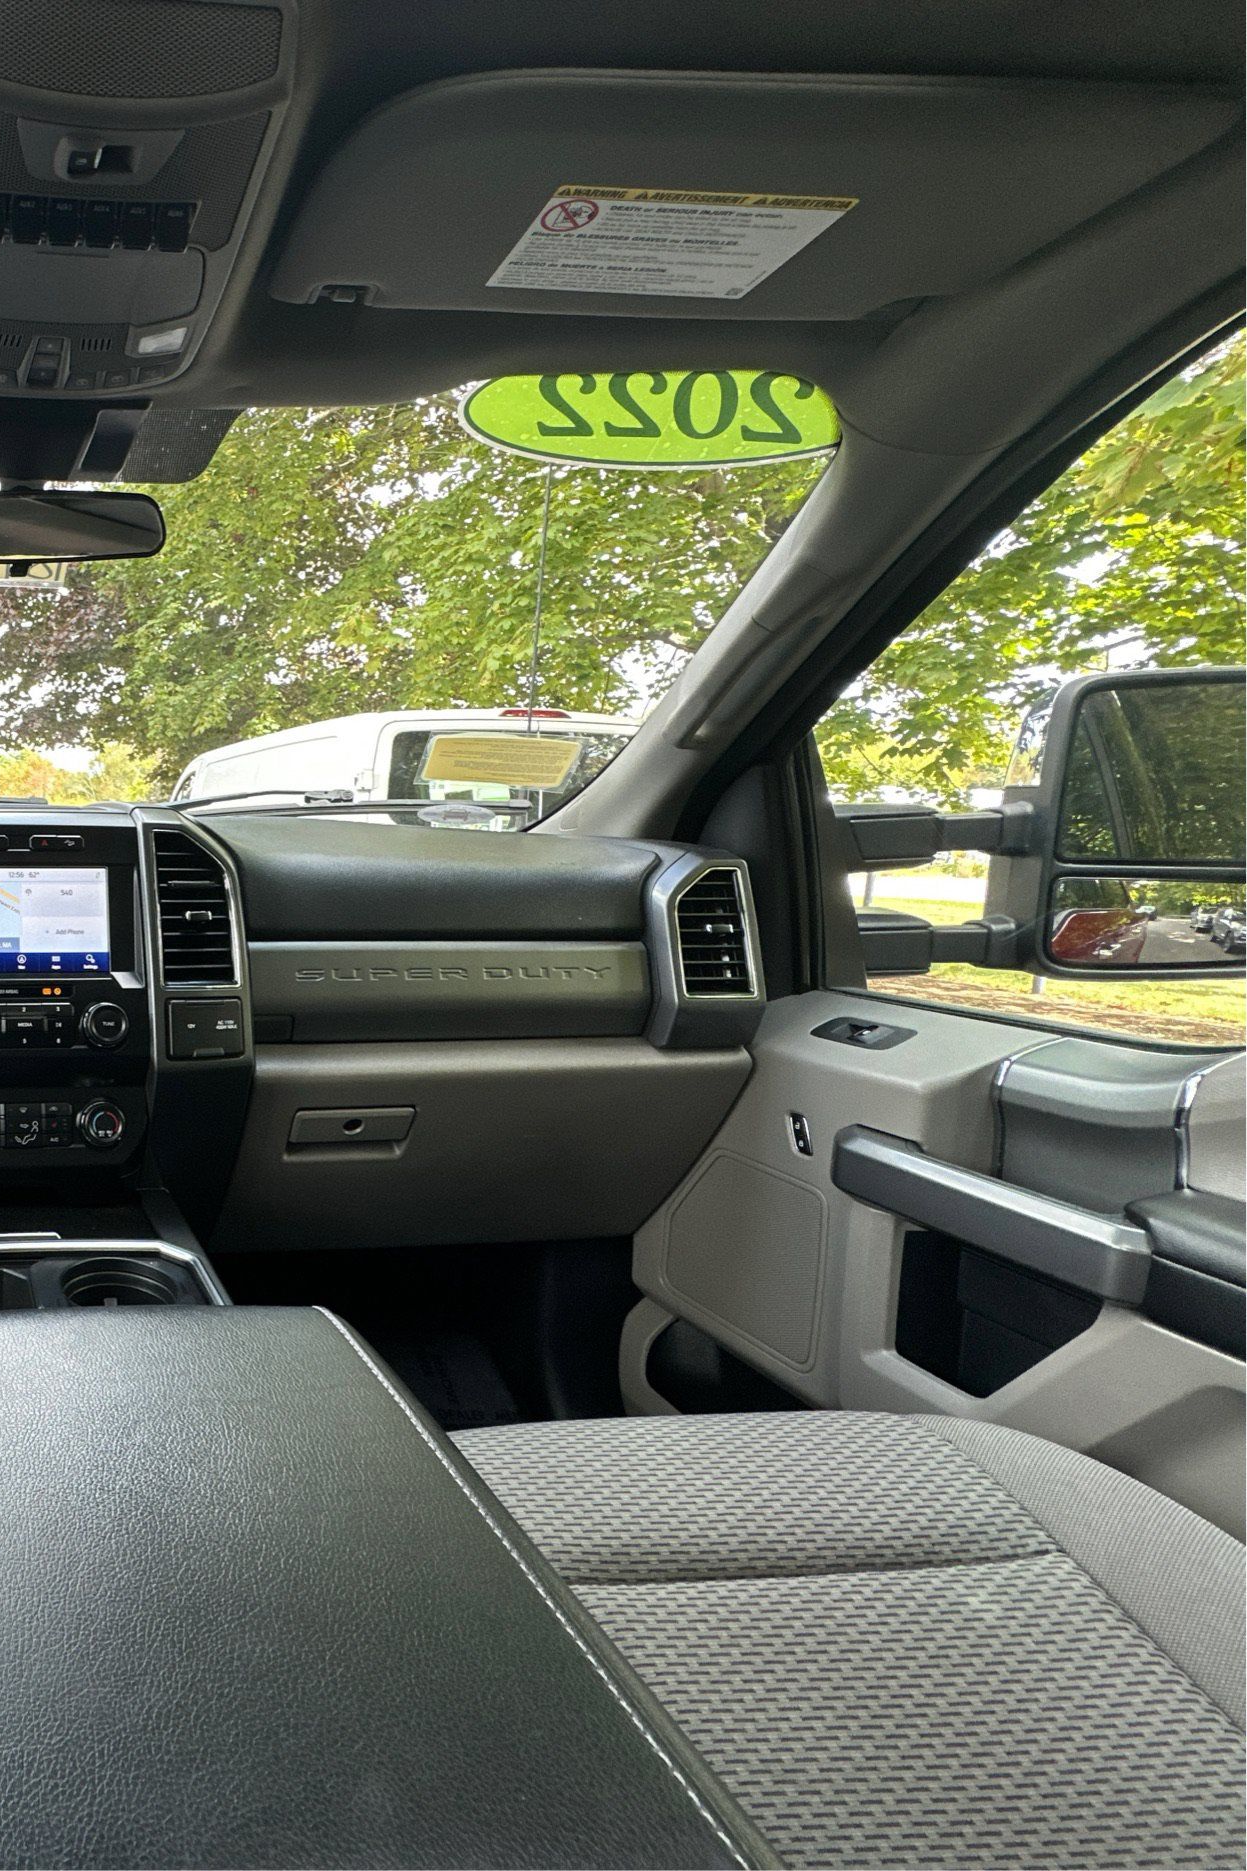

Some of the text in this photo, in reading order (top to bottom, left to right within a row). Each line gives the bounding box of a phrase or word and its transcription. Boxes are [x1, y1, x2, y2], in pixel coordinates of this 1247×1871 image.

[572, 188, 629, 199] WARNING
[650, 190, 751, 205] AVERTISSEMENT
[295, 965, 612, 982] SUPER DUTY
